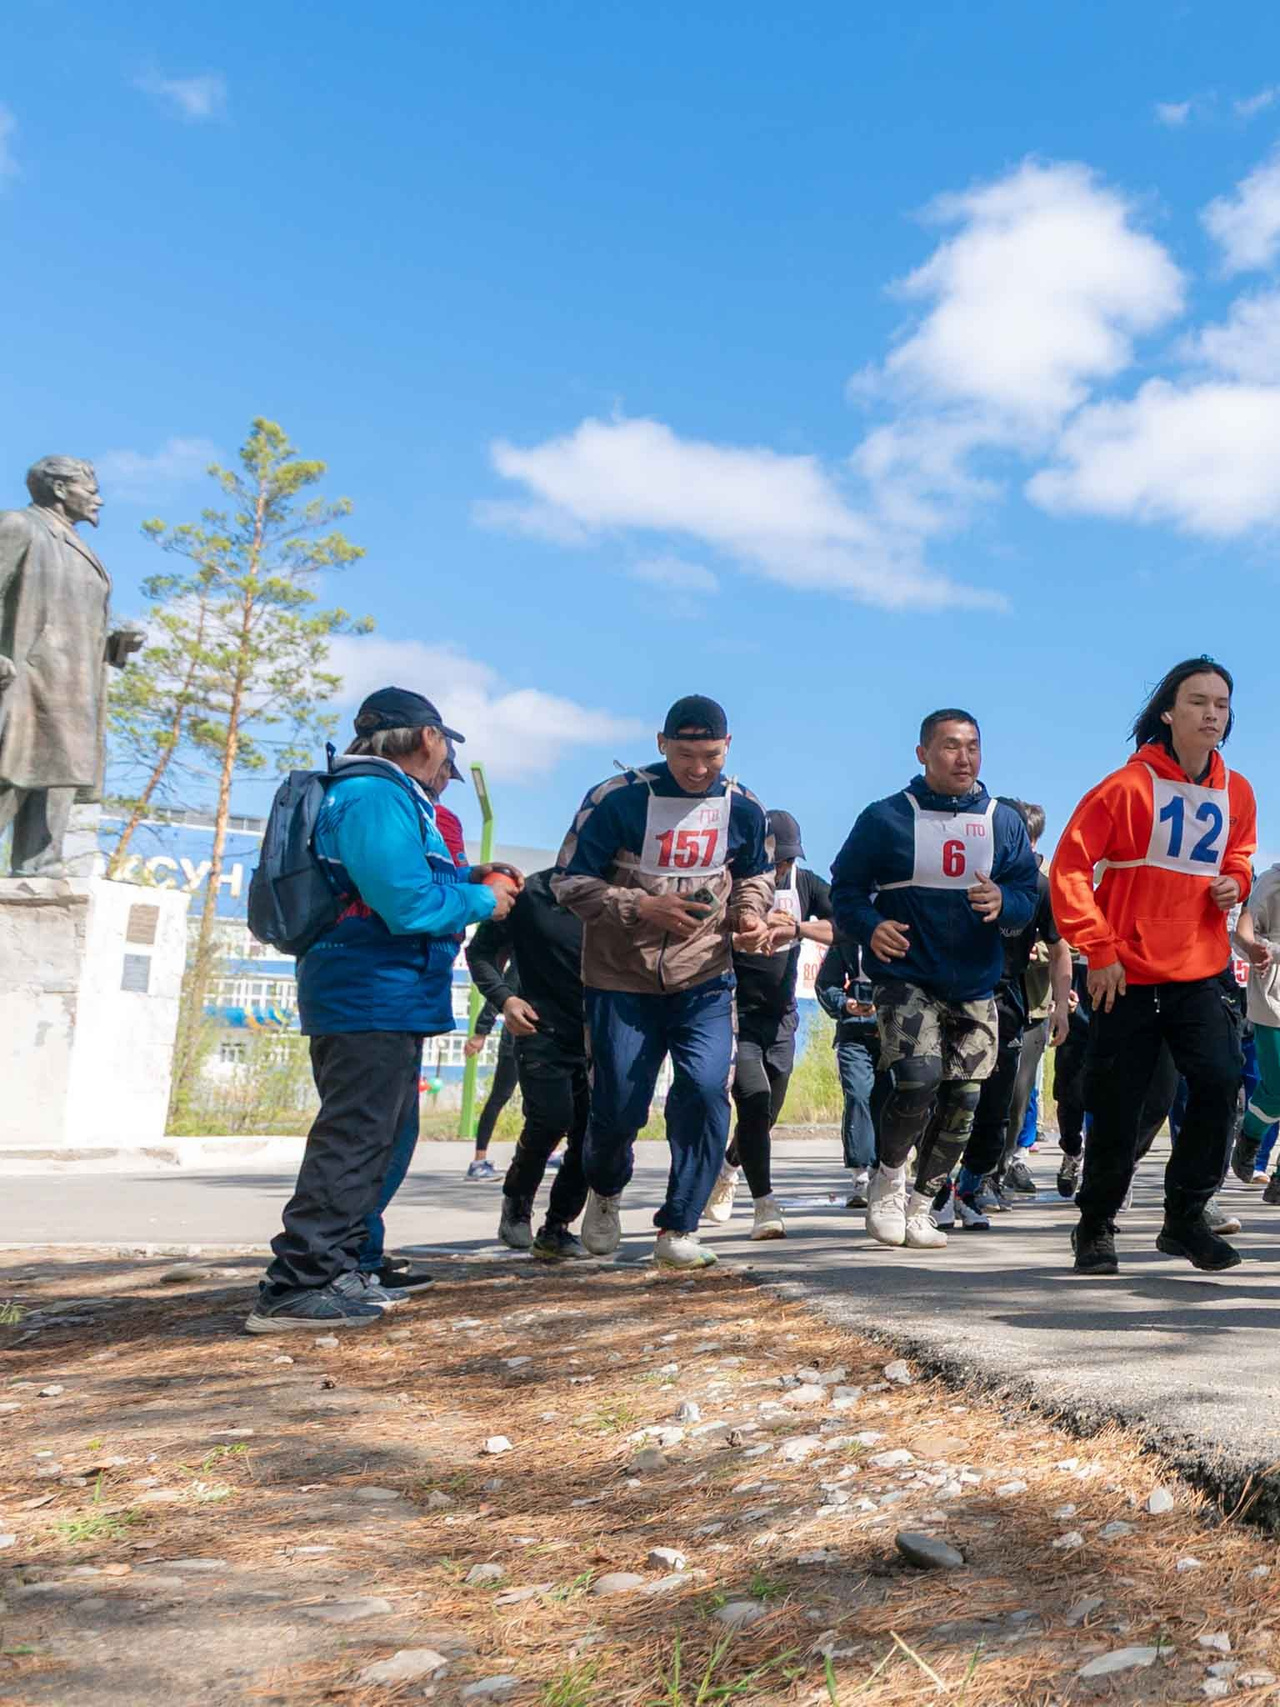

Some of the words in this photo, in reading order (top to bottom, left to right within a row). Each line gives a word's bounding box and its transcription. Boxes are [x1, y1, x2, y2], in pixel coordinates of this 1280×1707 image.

[655, 827, 719, 868] 157
[965, 823, 986, 837] ГТО
[1159, 795, 1223, 864] 12
[942, 839, 966, 877] 6
